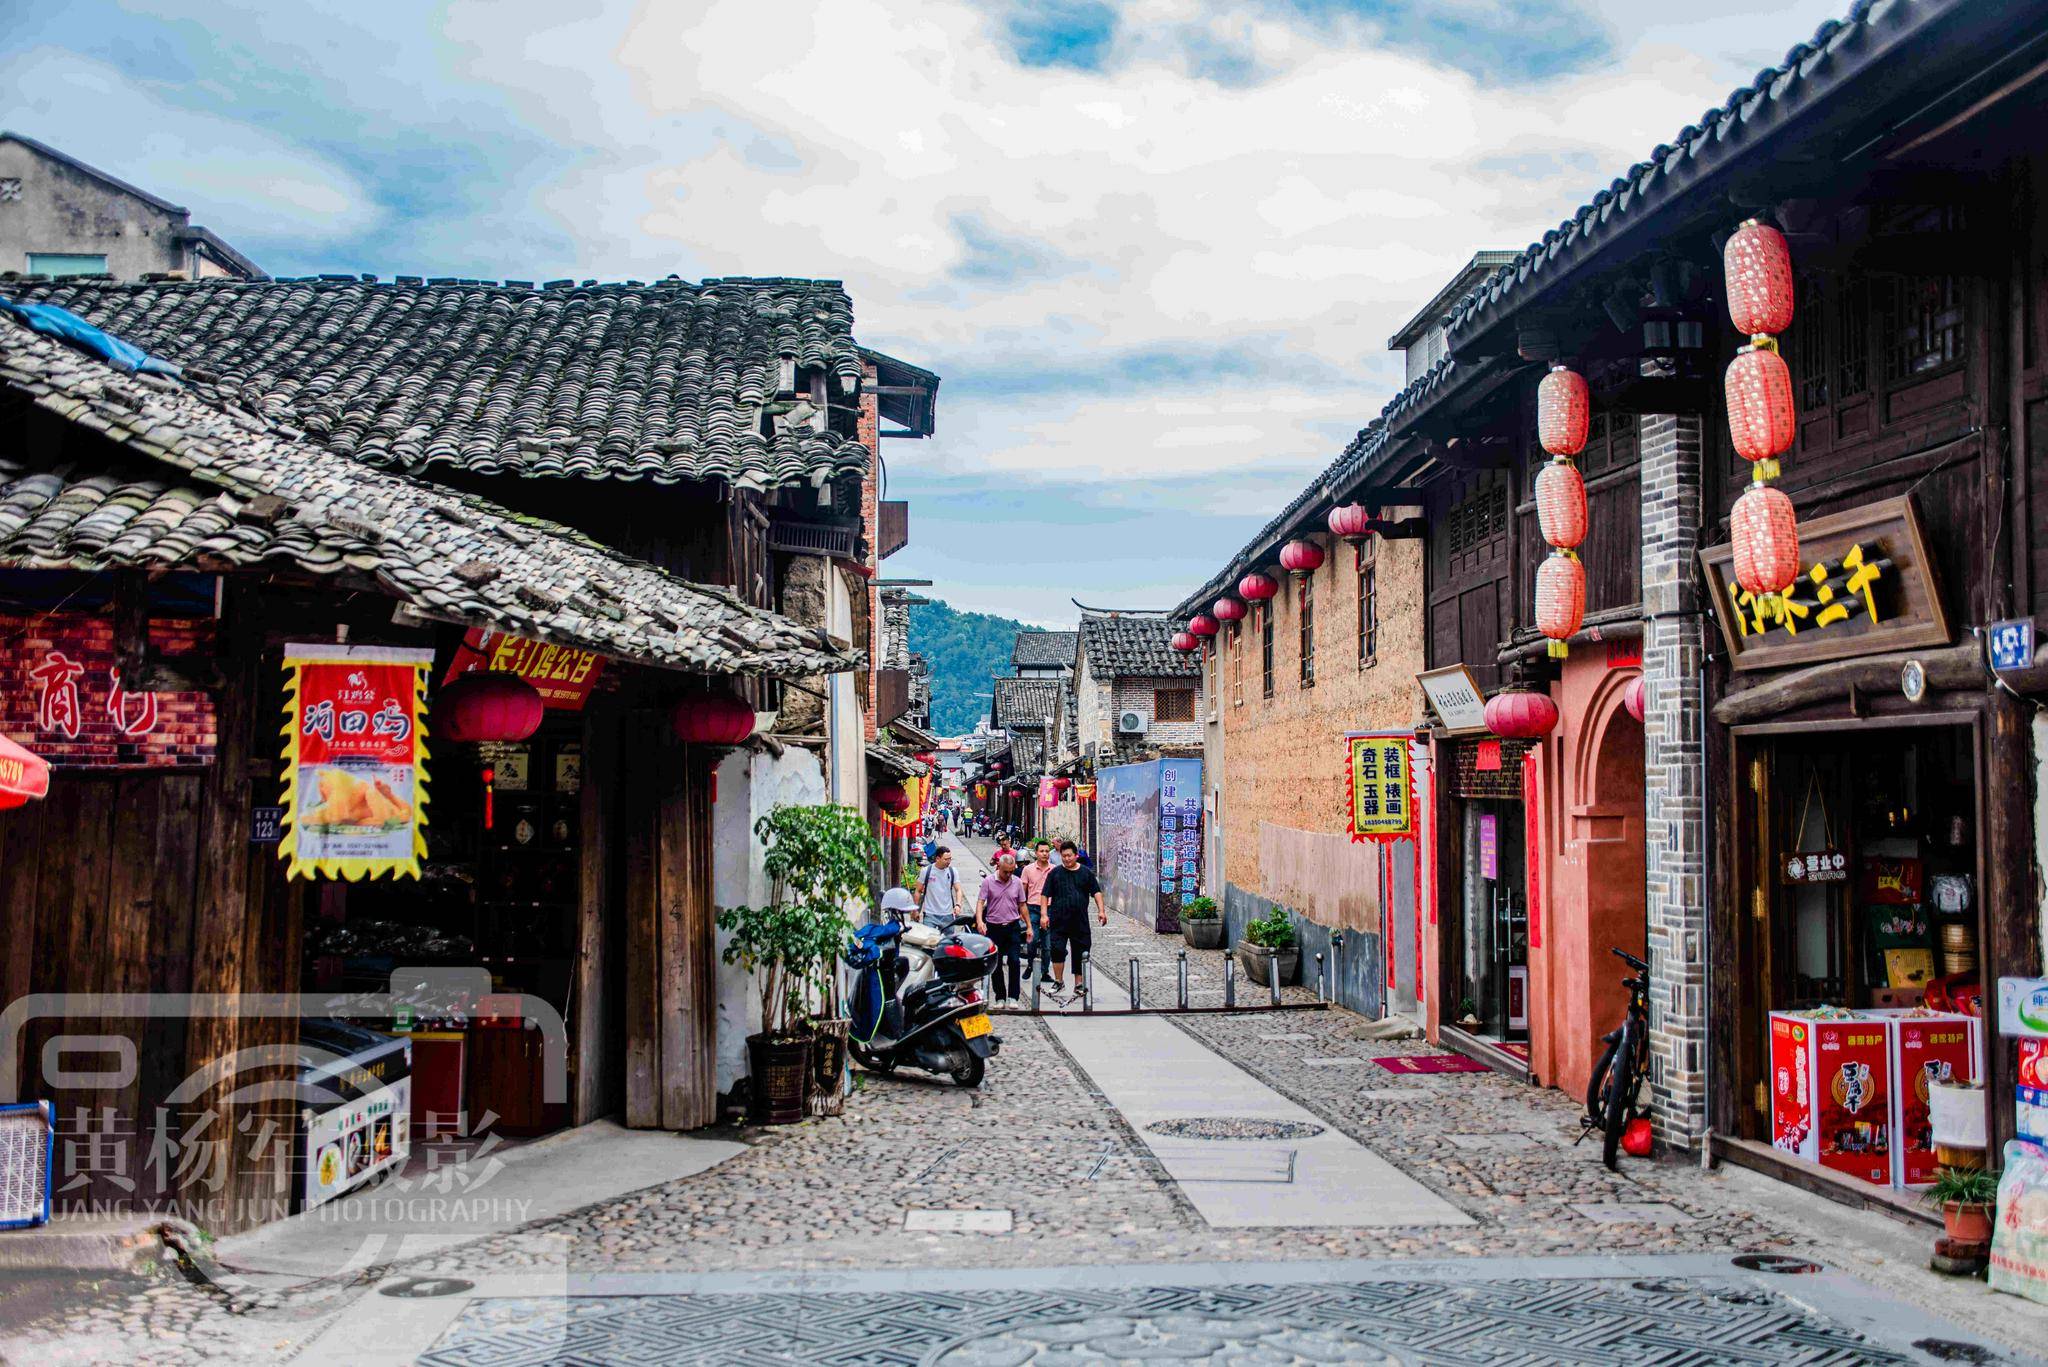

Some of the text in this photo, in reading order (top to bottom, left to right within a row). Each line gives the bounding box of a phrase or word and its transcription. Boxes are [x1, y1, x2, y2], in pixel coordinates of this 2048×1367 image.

[30, 652, 158, 739] 商行
[303, 699, 411, 742] 河田鸡
[256, 821, 273, 838] 123
[1161, 769, 1177, 894] 创建全国文明城市
[1806, 854, 1845, 871] 营业中
[1842, 1062, 1862, 1113] 豆腐干
